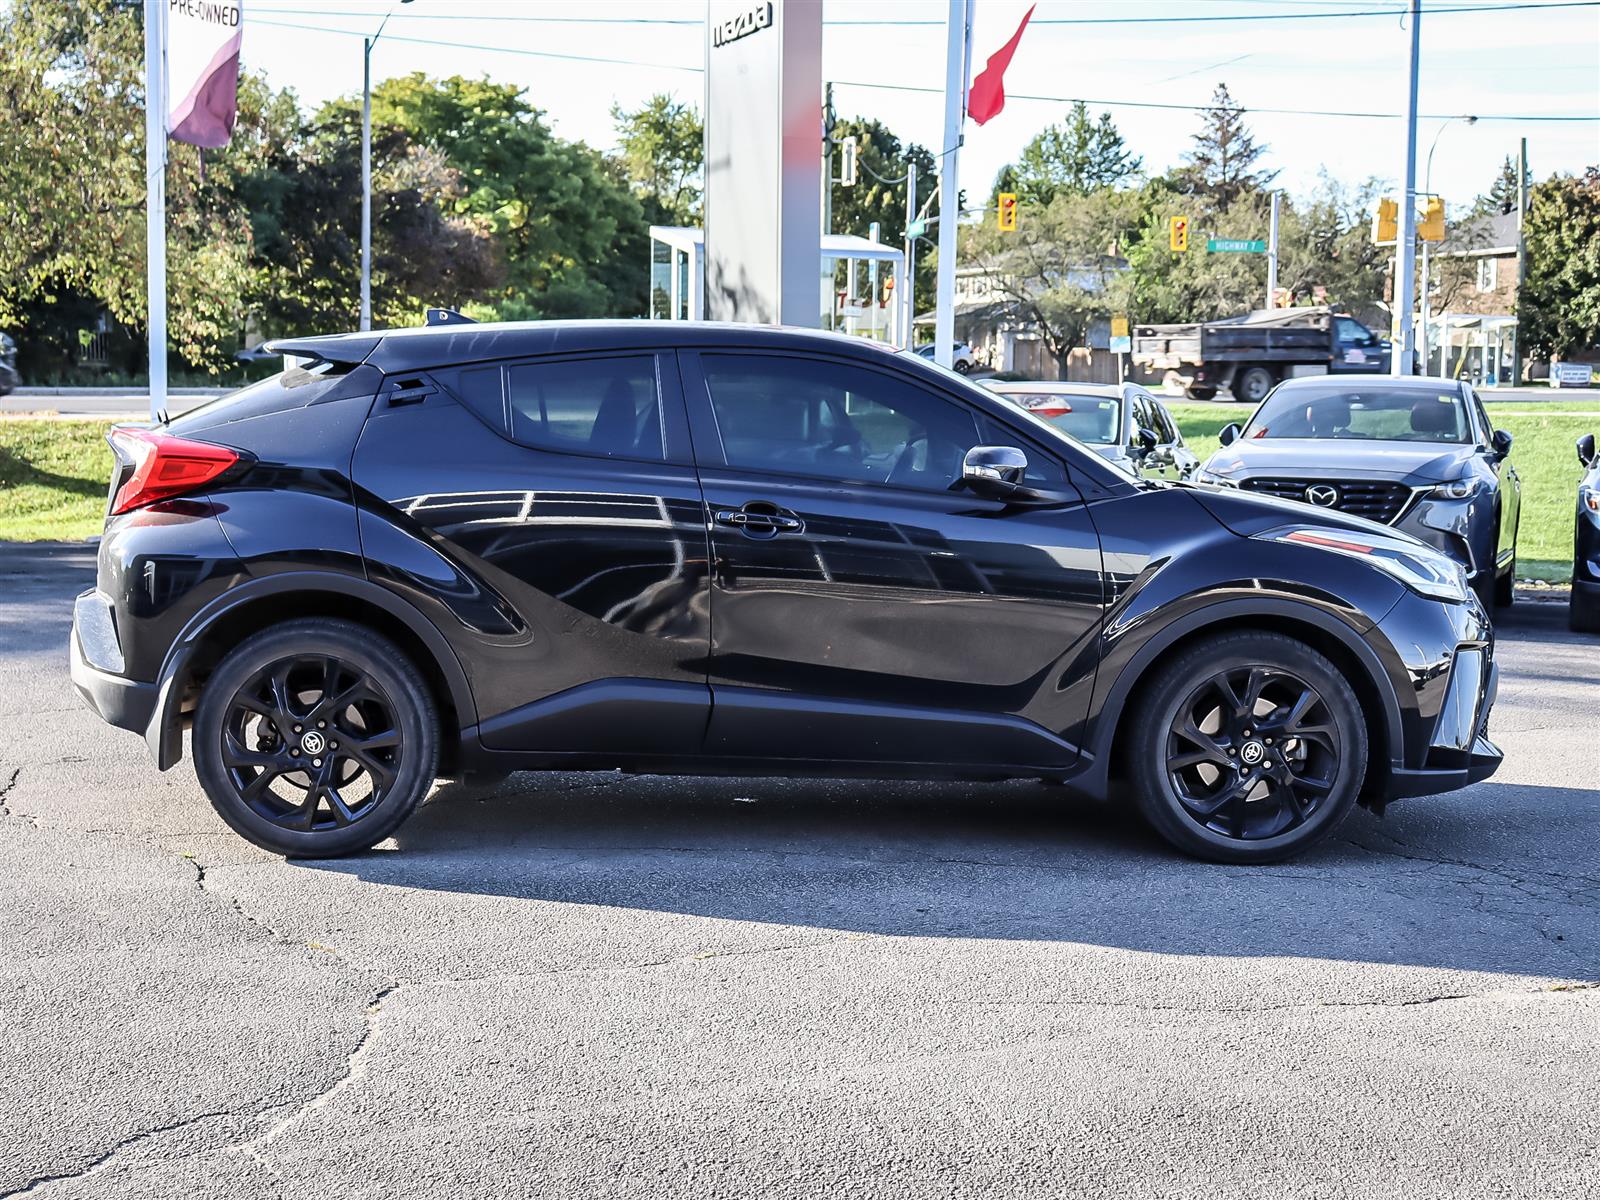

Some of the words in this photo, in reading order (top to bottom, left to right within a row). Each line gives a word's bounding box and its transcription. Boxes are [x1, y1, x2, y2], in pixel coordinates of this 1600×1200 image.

[170, 0, 240, 27] PRE-OWNED
[1215, 241, 1249, 251] HIGHWAY
[1250, 241, 1257, 251] 7
